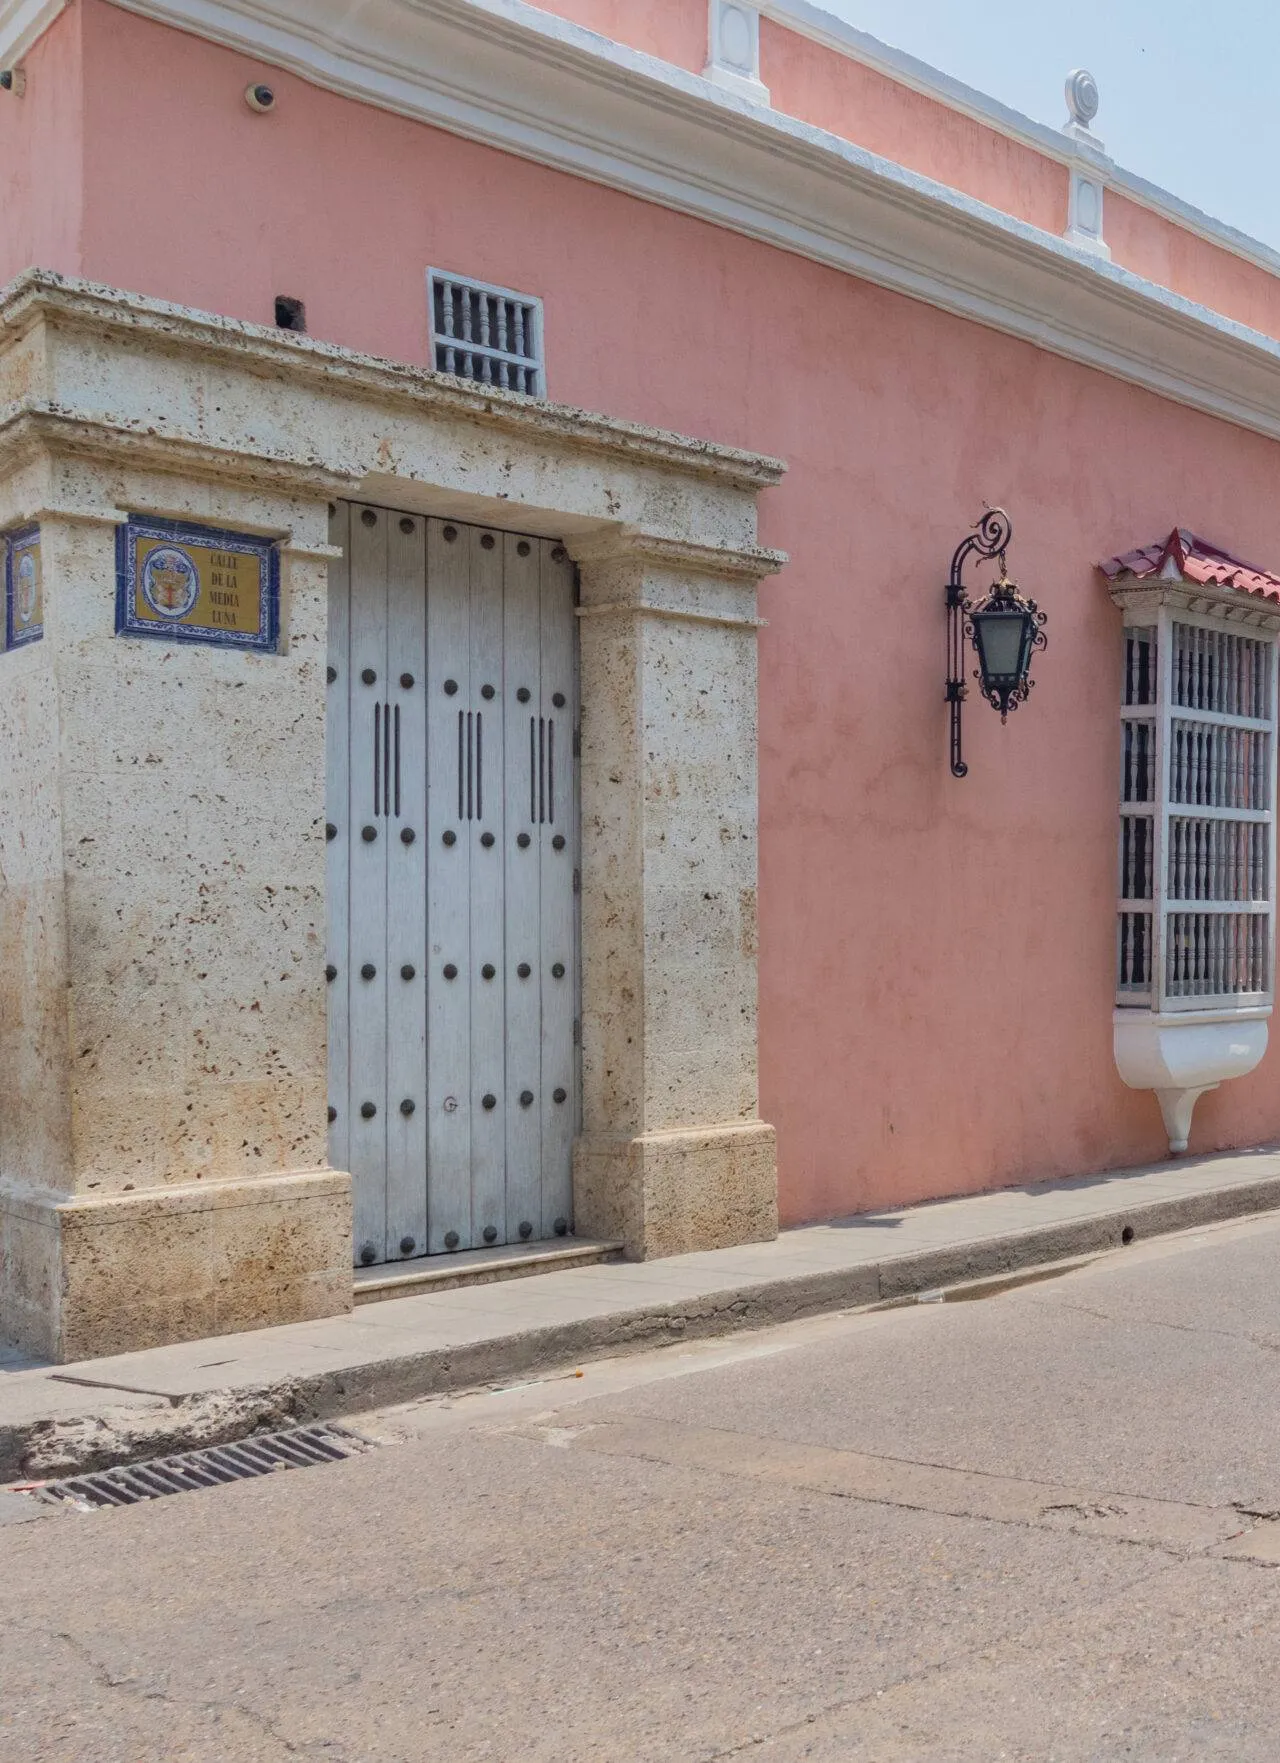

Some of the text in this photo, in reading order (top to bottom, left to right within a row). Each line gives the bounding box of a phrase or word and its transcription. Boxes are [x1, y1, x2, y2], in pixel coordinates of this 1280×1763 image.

[209, 553, 238, 569] CALLE
[212, 572, 237, 588] DE LA
[210, 591, 239, 607] MEDIA
[212, 610, 237, 625] LUNA
